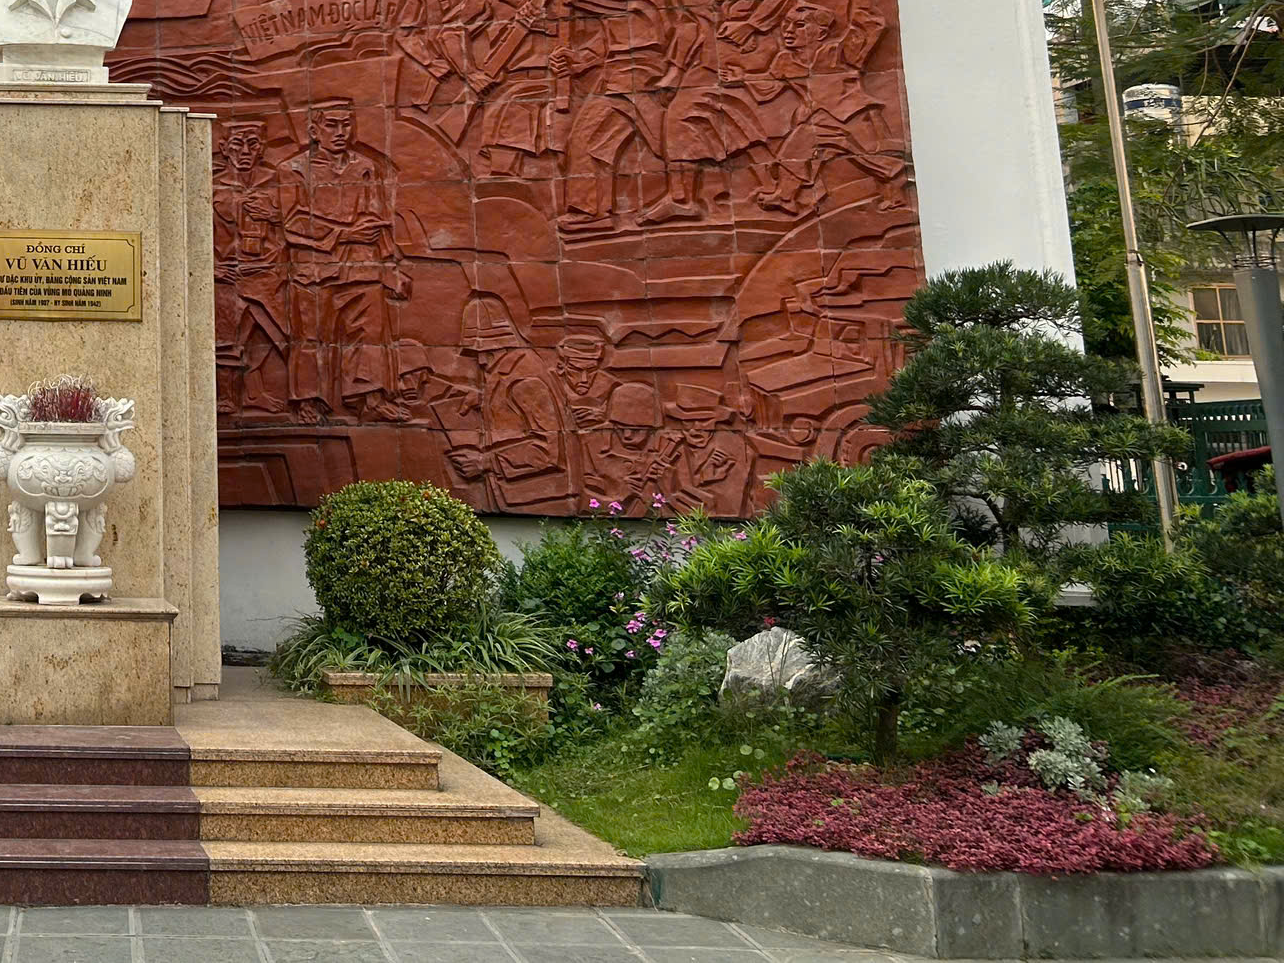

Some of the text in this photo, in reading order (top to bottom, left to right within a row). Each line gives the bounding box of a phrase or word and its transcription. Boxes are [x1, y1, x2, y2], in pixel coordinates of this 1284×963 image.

[241, 13, 278, 44] VIỆT
[280, 3, 326, 33] NAM
[64, 243, 85, 254] CHÍ
[5, 254, 107, 271] VŨ VĂN HIẾU
[20, 275, 33, 283] KHU
[83, 273, 97, 285] SẢN
[97, 276, 111, 286] VIỆT
[112, 277, 127, 286] NAM
[14, 286, 28, 295] TIÊN
[29, 284, 42, 296] CỦA
[73, 285, 95, 297] QUẢNG
[96, 289, 112, 297] NINH
